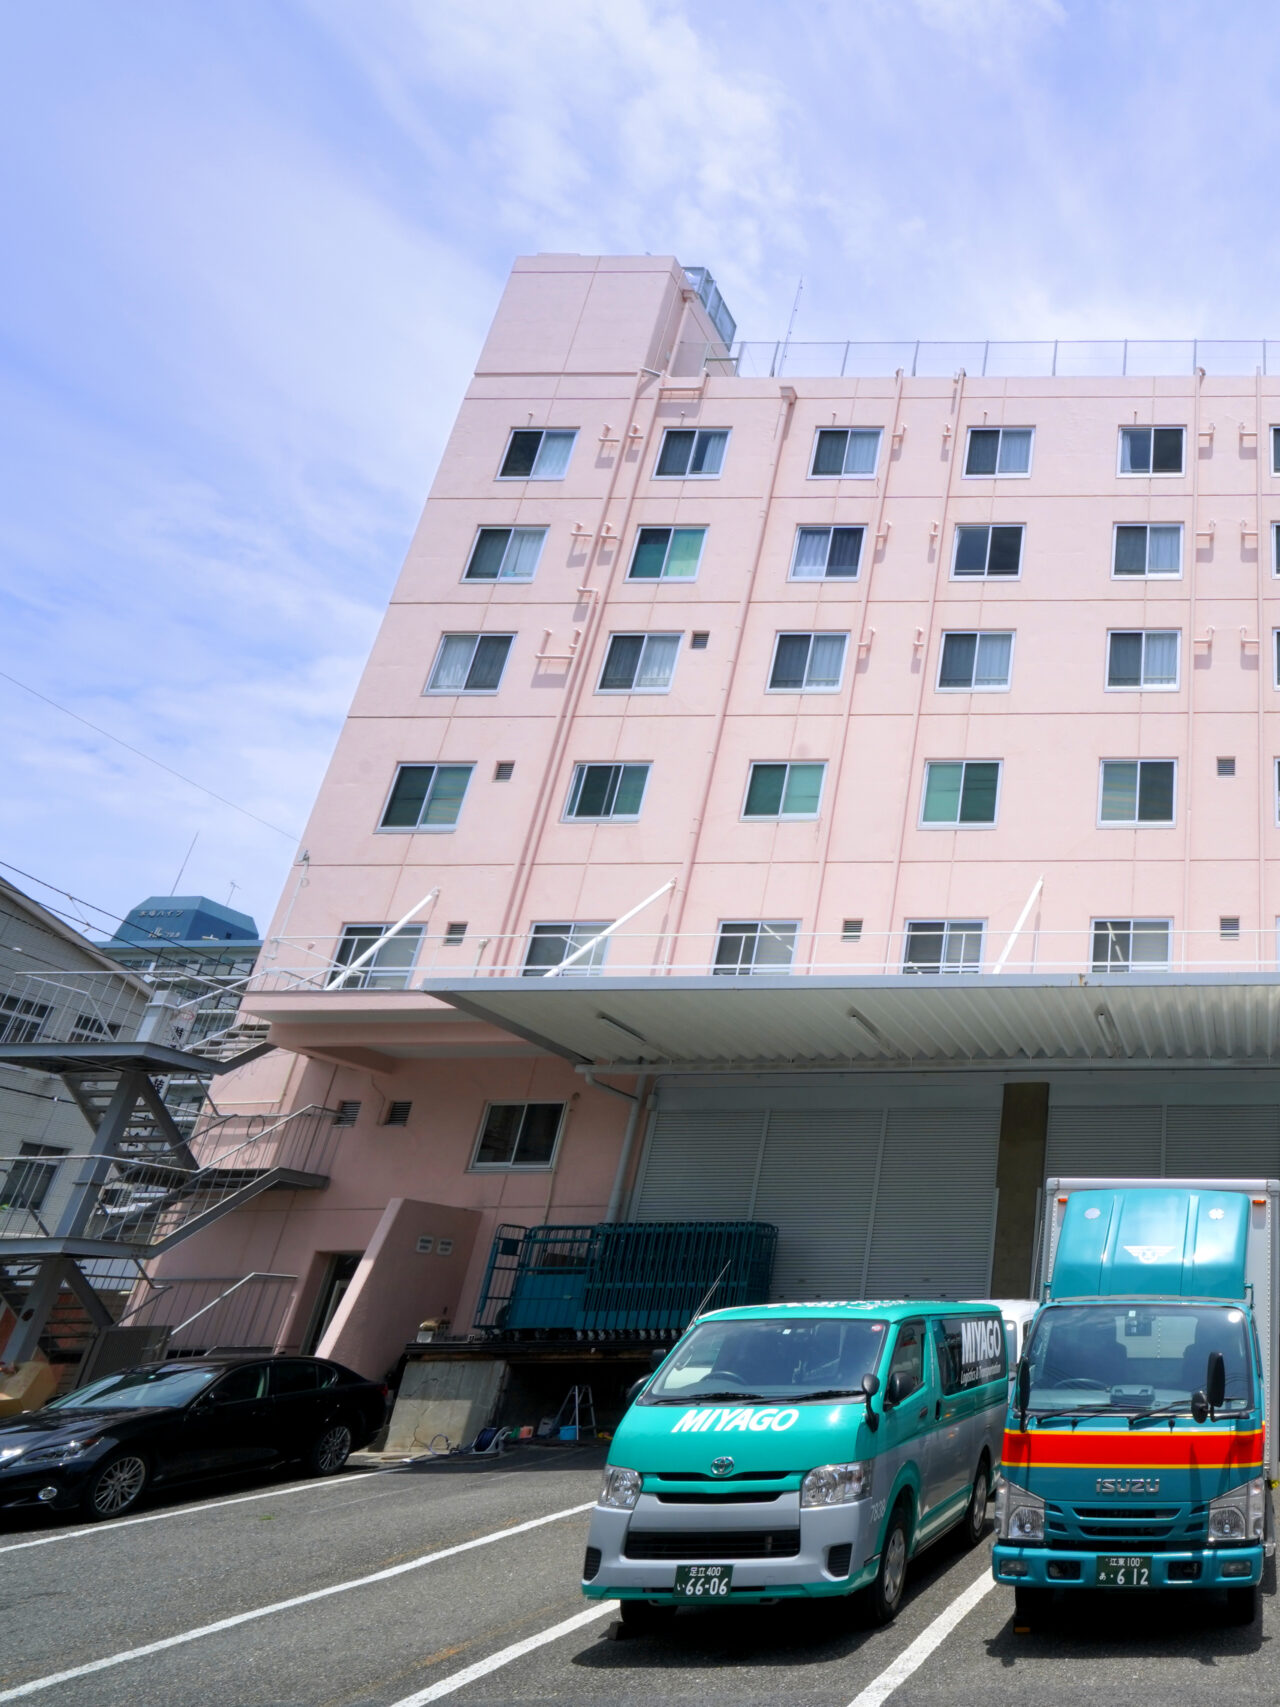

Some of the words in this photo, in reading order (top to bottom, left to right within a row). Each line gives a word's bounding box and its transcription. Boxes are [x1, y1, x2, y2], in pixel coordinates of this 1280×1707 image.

[961, 1320, 1001, 1365] MIYAGO
[671, 1408, 799, 1433] MIYAGO
[1095, 1478, 1160, 1493] ISUZU
[1127, 1557, 1141, 1567] 100
[689, 1566, 705, 1577] 足立
[706, 1566, 721, 1577] 400
[685, 1577, 729, 1595] 66-06
